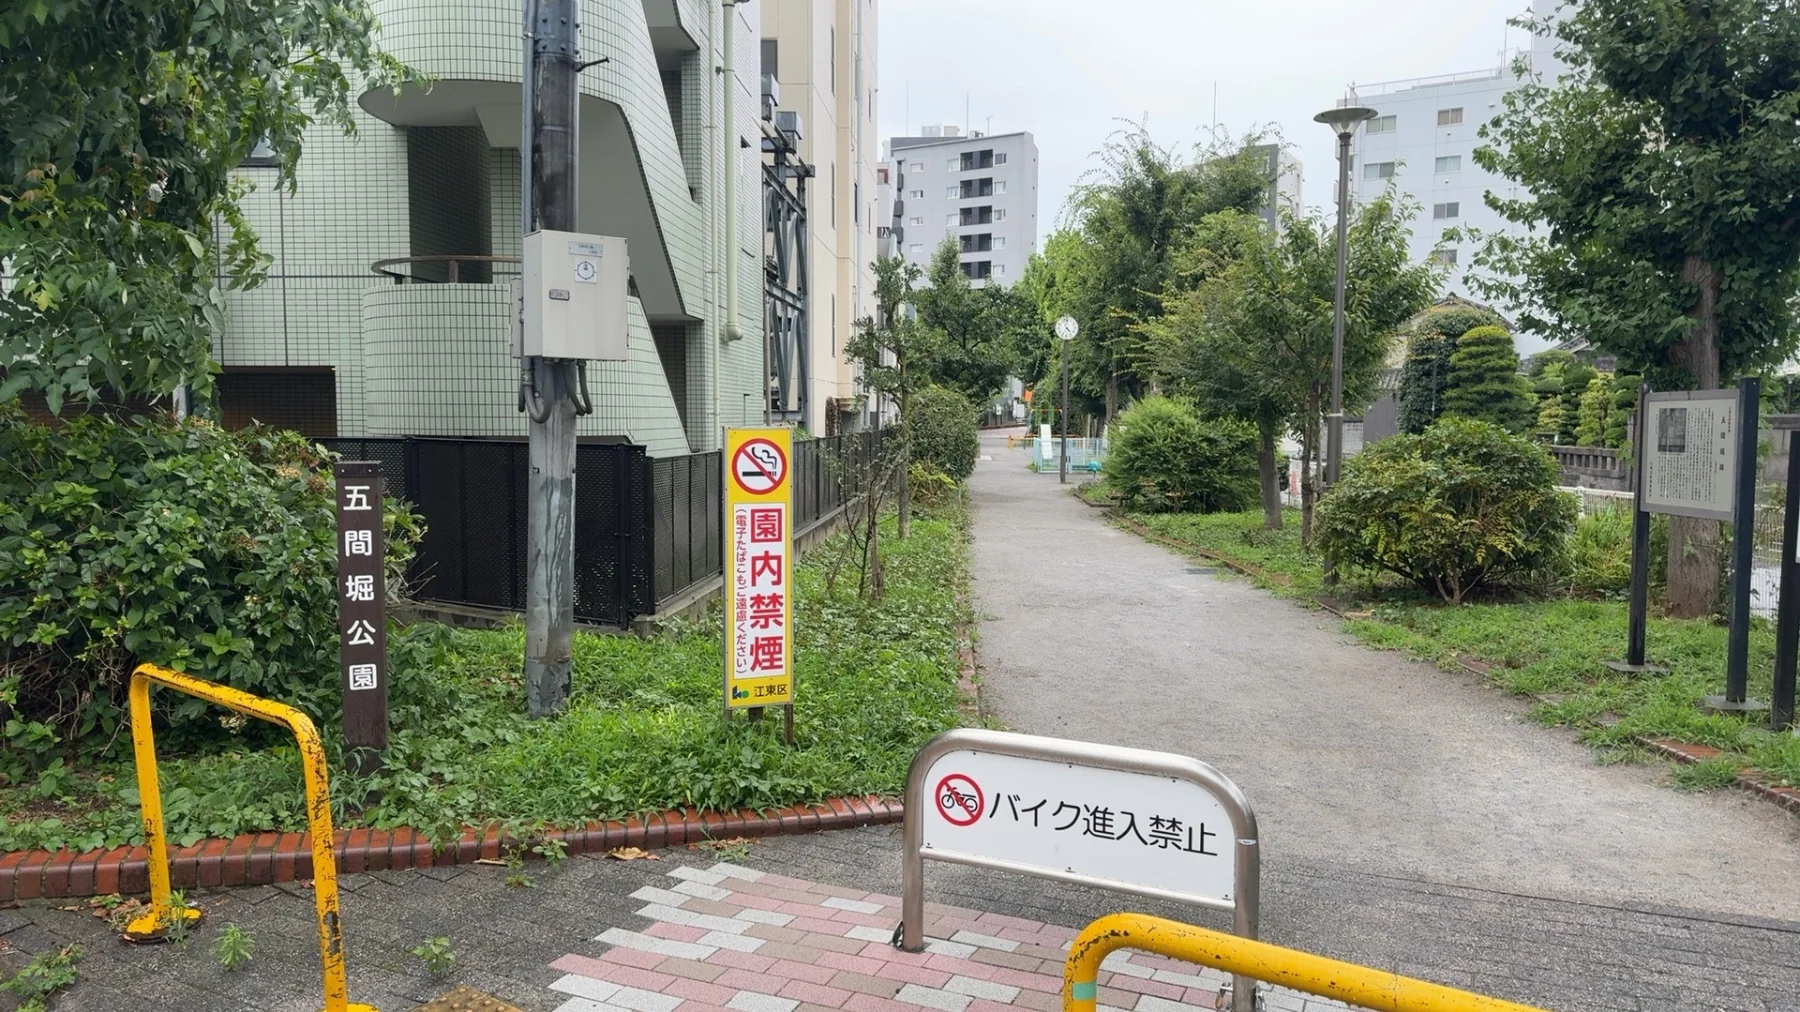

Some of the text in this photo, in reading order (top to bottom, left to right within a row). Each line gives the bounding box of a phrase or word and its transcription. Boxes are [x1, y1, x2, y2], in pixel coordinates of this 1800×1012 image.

[343, 485, 378, 691] 五間堀公園
[749, 508, 784, 673] 園内禁煙
[754, 684, 788, 698] 江東区
[989, 793, 1218, 857] バイク進入禁止
